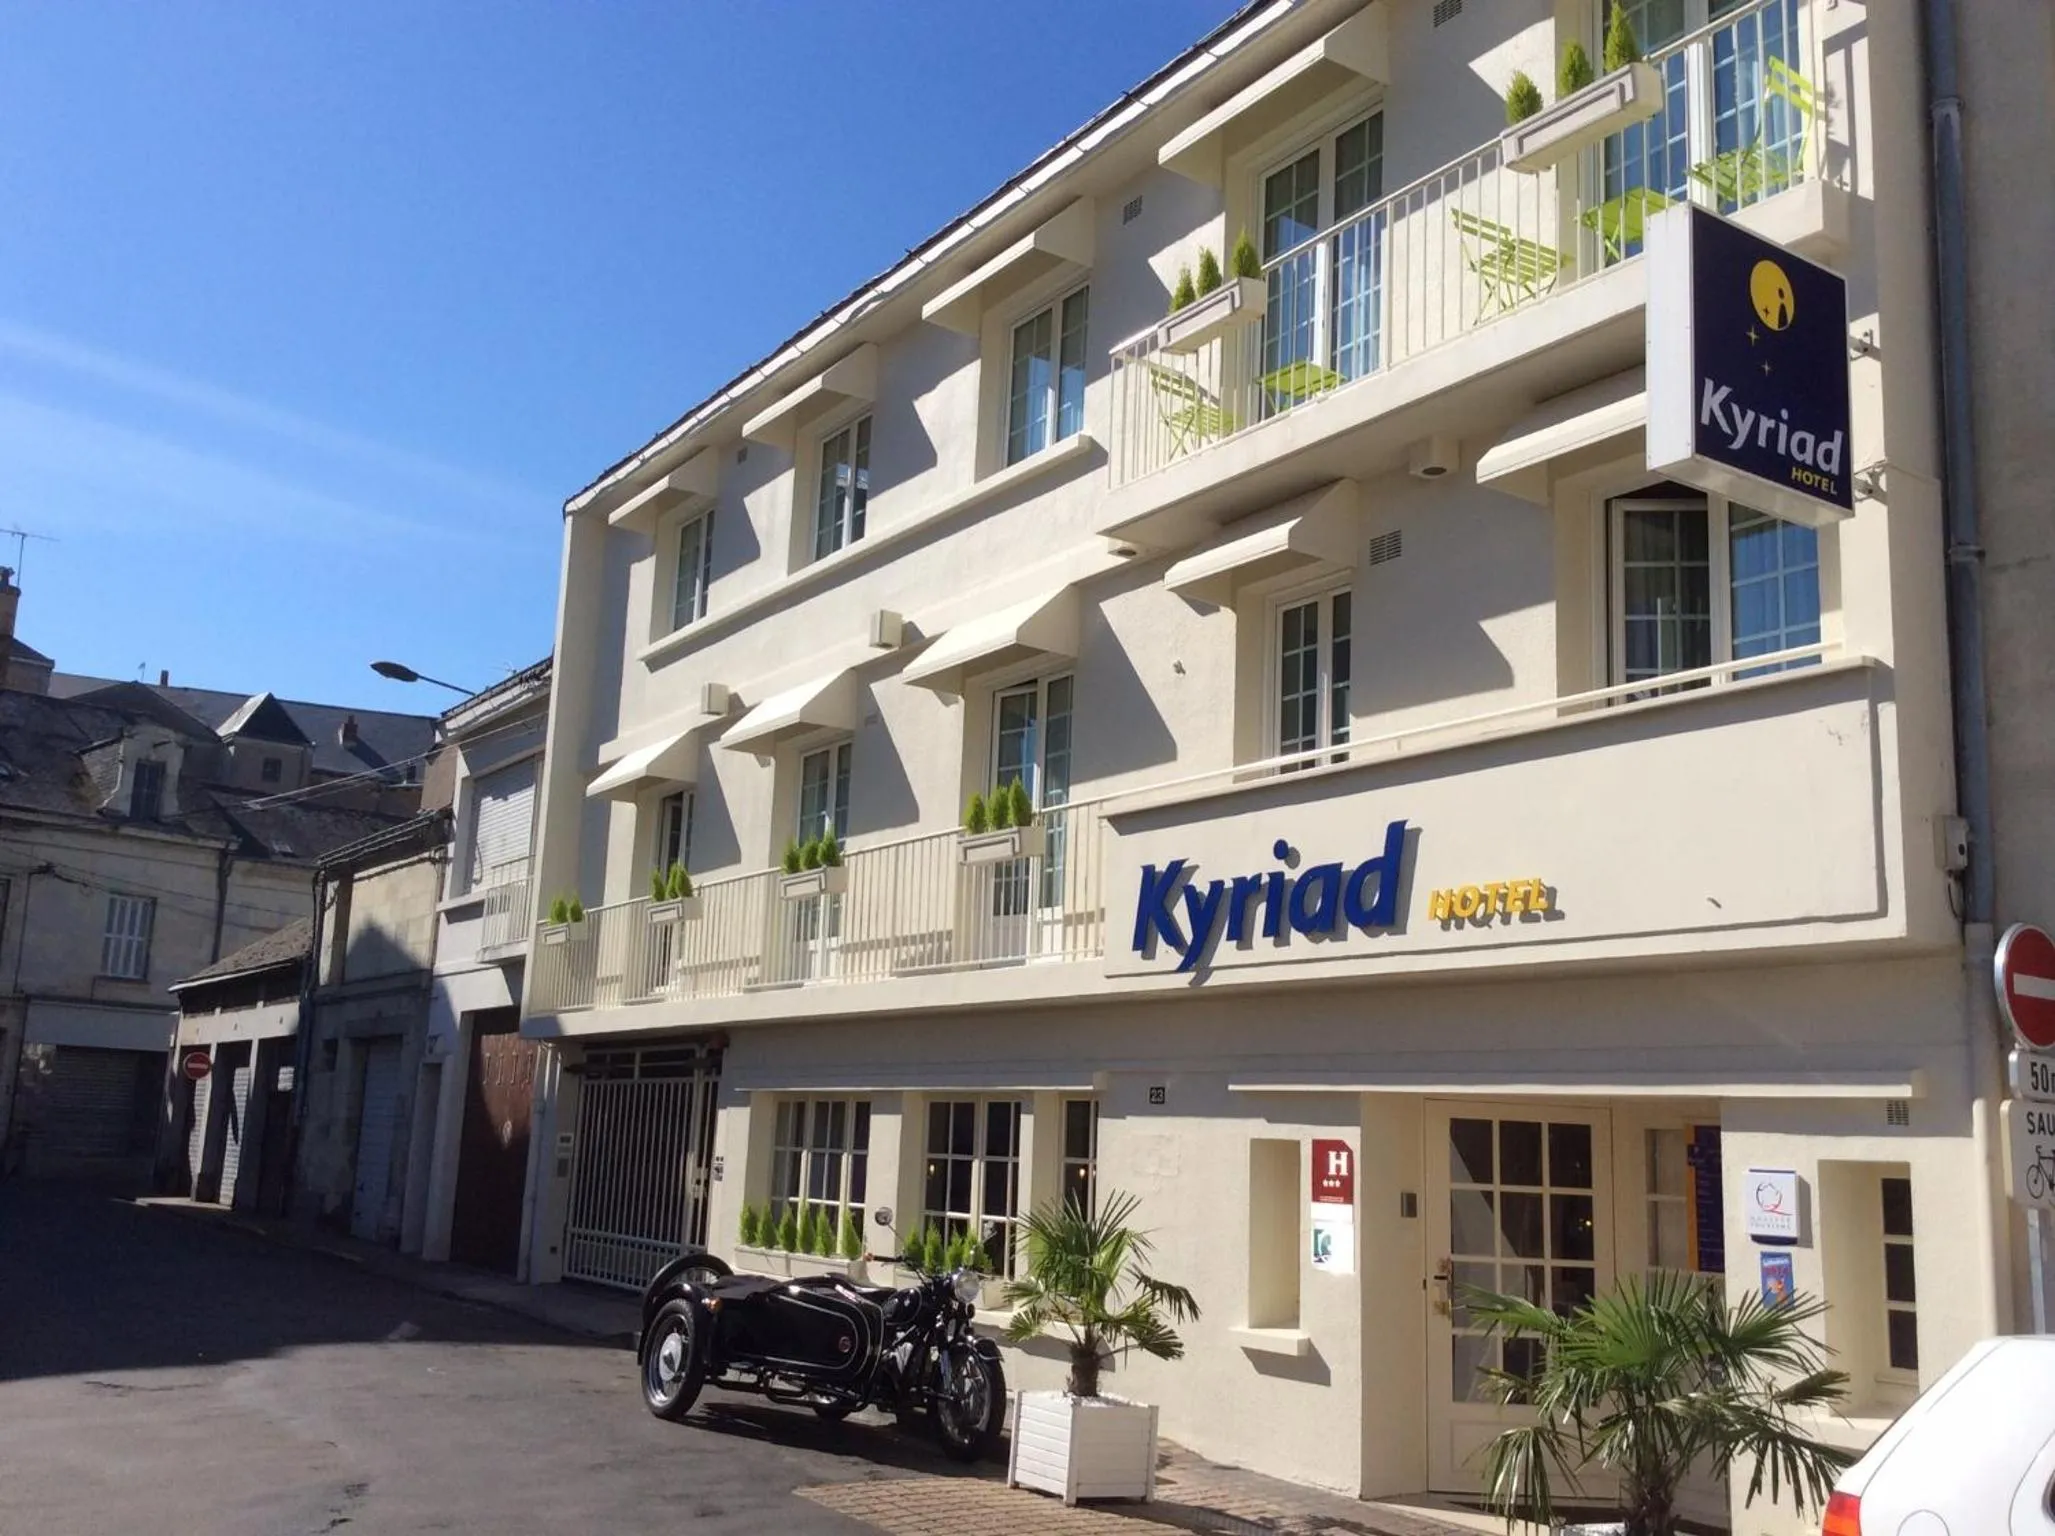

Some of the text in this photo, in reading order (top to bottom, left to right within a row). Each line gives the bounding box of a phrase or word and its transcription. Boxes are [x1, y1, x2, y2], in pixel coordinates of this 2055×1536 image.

[1700, 377, 1844, 476] Kyriad
[1791, 467, 1838, 495] HOTEL
[1132, 819, 1549, 972] Kyriad HOTEL
[1328, 1151, 1349, 1176] H
